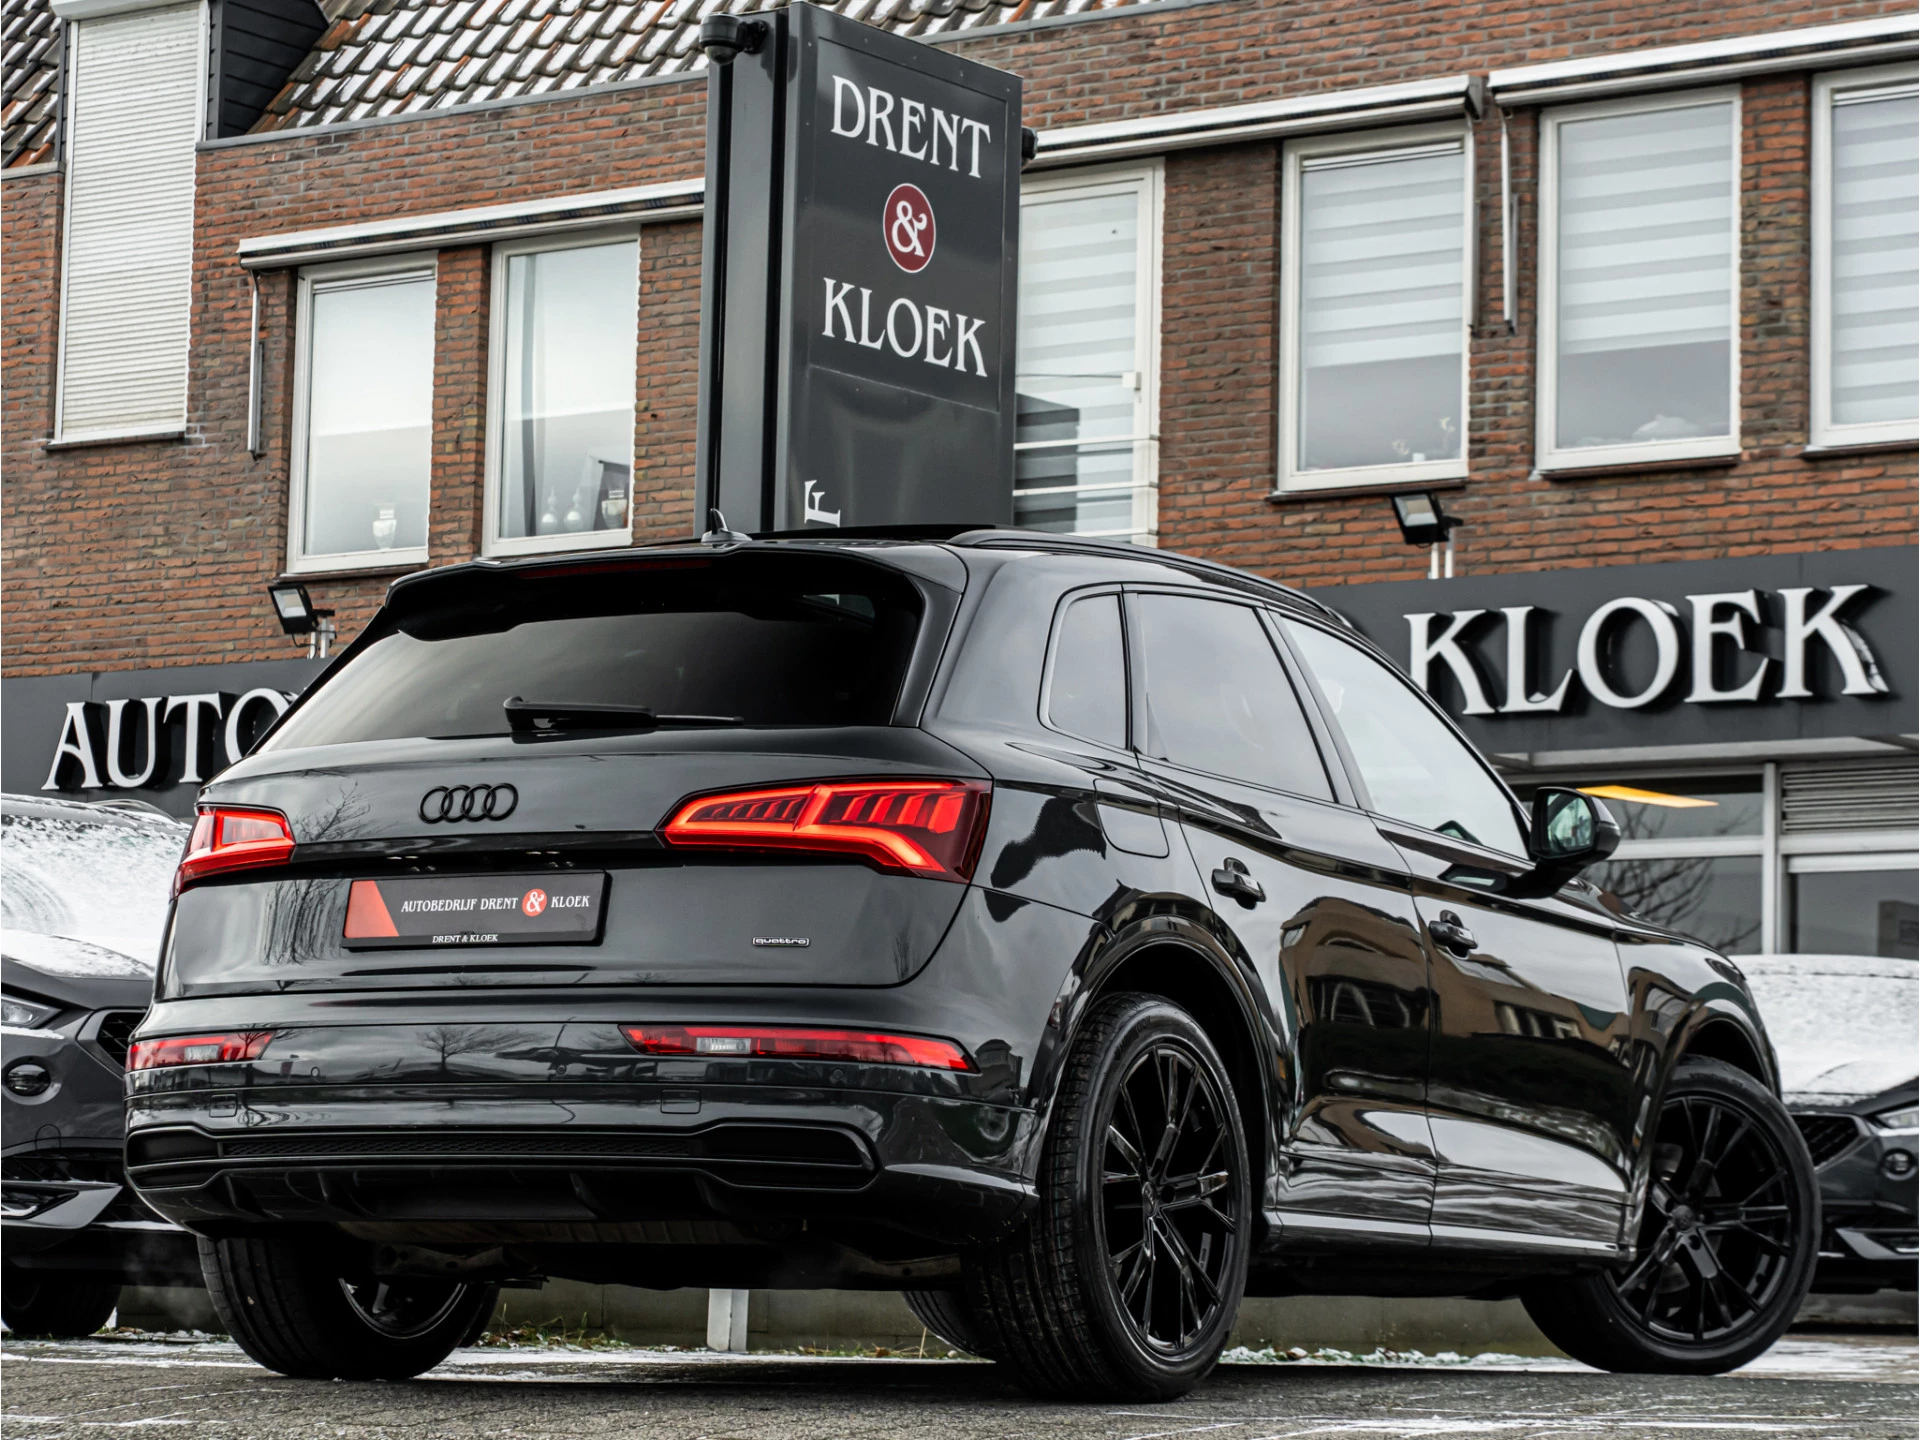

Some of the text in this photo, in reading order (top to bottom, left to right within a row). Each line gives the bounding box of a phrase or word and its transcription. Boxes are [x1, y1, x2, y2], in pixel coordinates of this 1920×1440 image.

[830, 74, 991, 179] DRENT
[892, 200, 927, 257] &
[822, 277, 988, 378] KLOEK
[1403, 584, 1882, 715] KLOEK
[400, 891, 590, 912] AUTOBEDRIJF DRENT & KLOEK
[432, 933, 498, 943] DRENT & KLOEK
